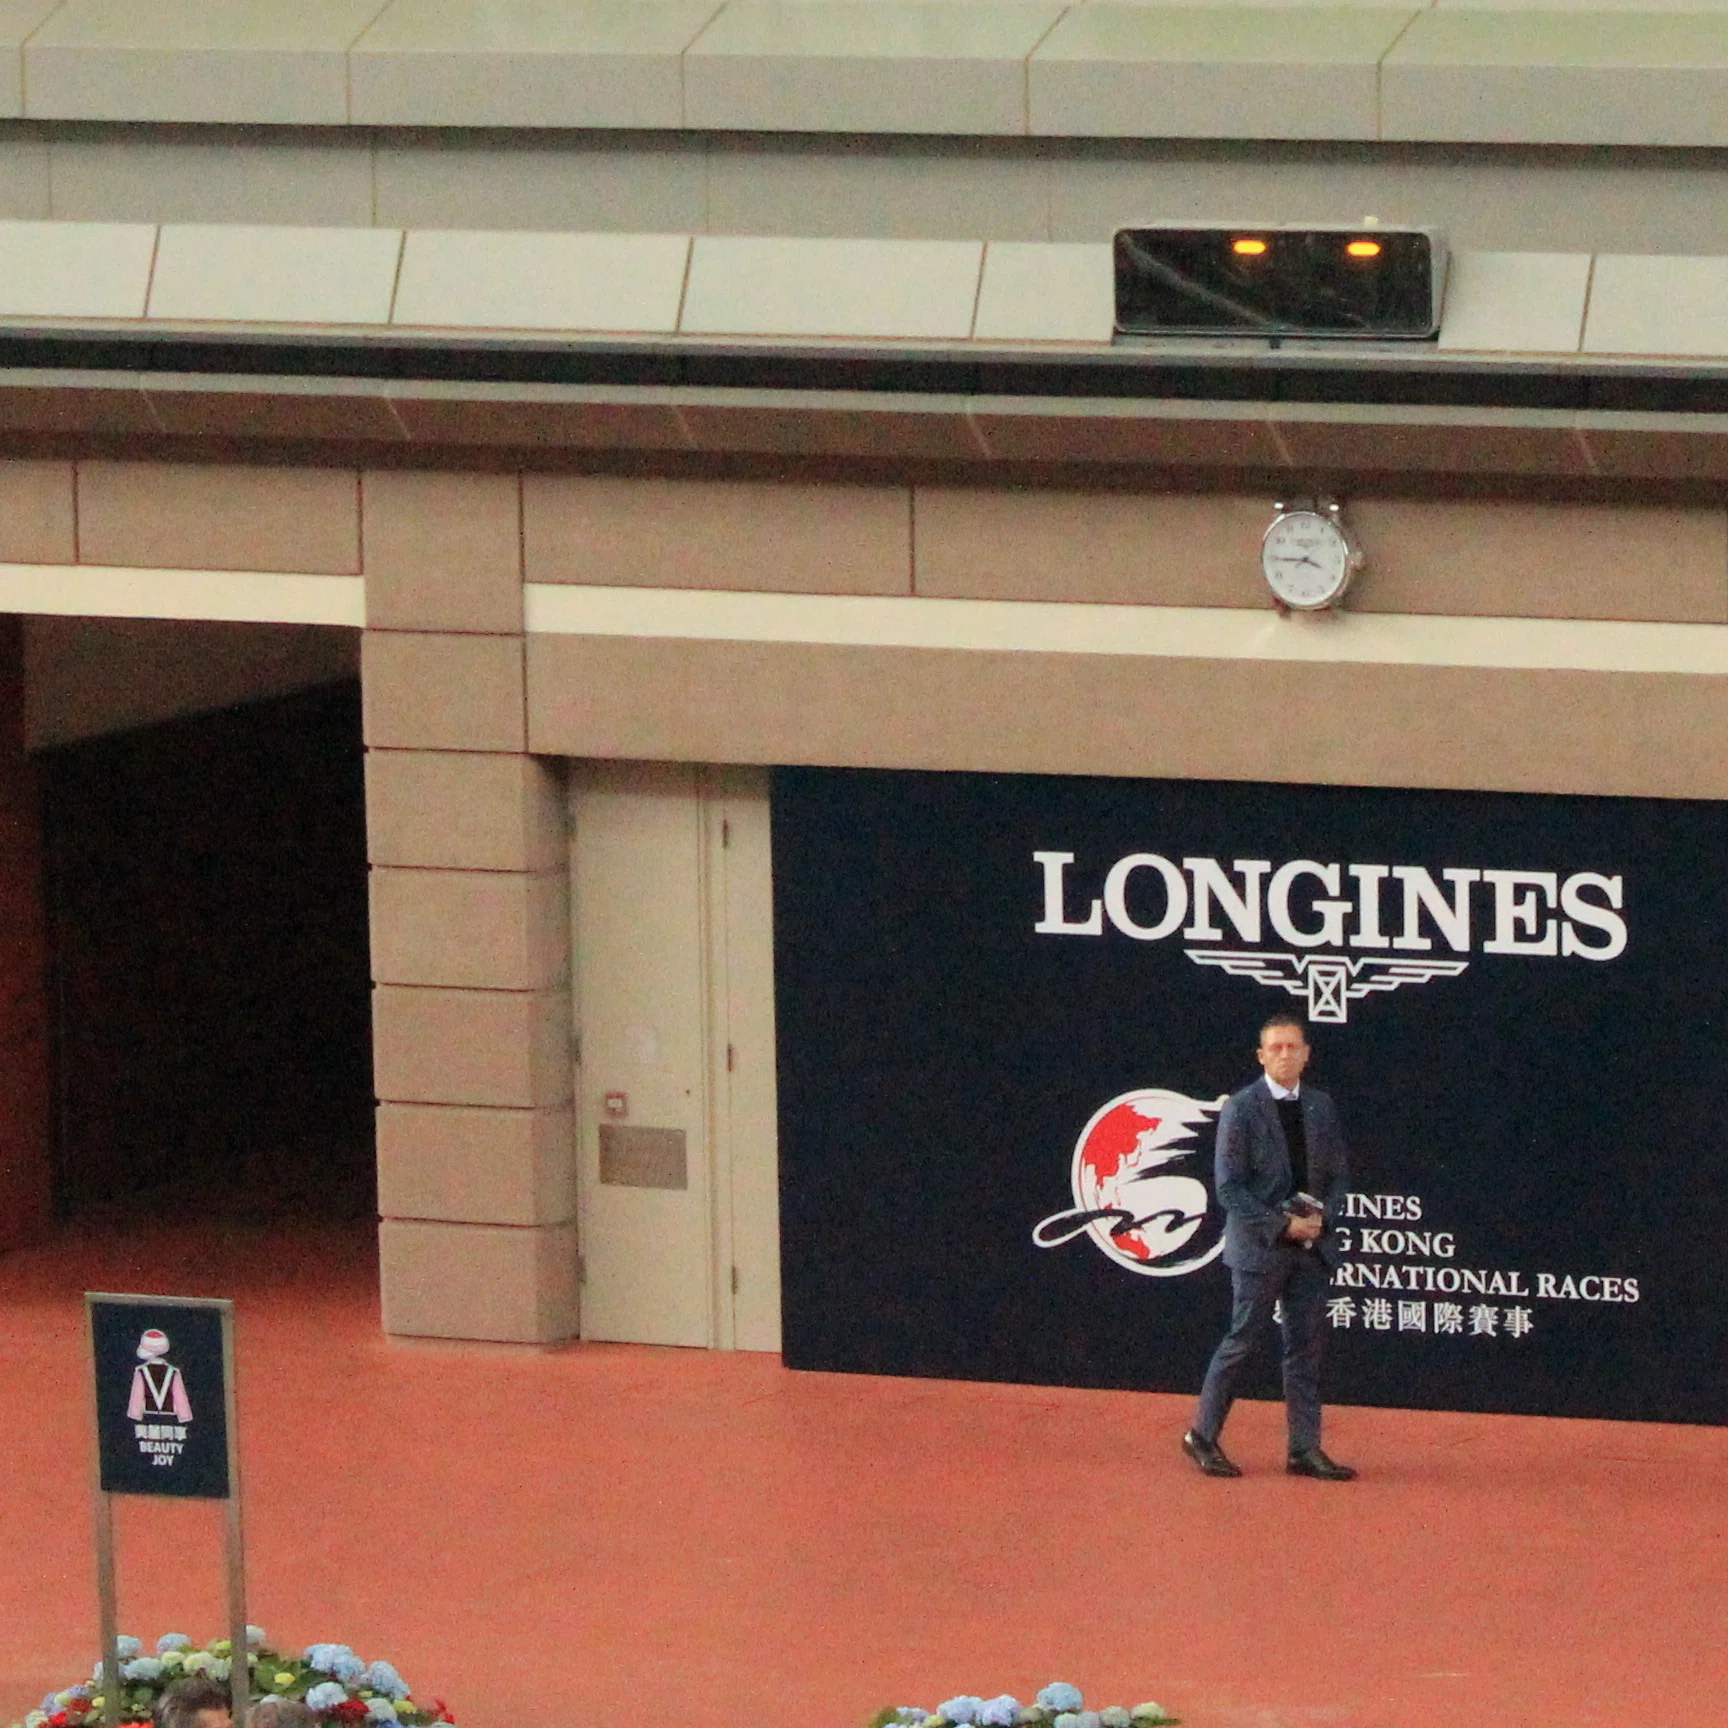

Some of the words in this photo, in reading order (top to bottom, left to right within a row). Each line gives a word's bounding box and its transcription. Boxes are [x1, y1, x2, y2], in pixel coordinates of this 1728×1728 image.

[1033, 851, 1627, 962] LONGINES
[1337, 1193, 1423, 1221] INES
[1359, 1228, 1456, 1258] KONG
[1329, 1262, 1529, 1297] RNATIONAL
[1536, 1273, 1640, 1303] RACES
[1325, 1296, 1534, 1339] 香港國際賽事
[138, 1440, 184, 1455] BEAUTY
[152, 1454, 174, 1466] JOY
